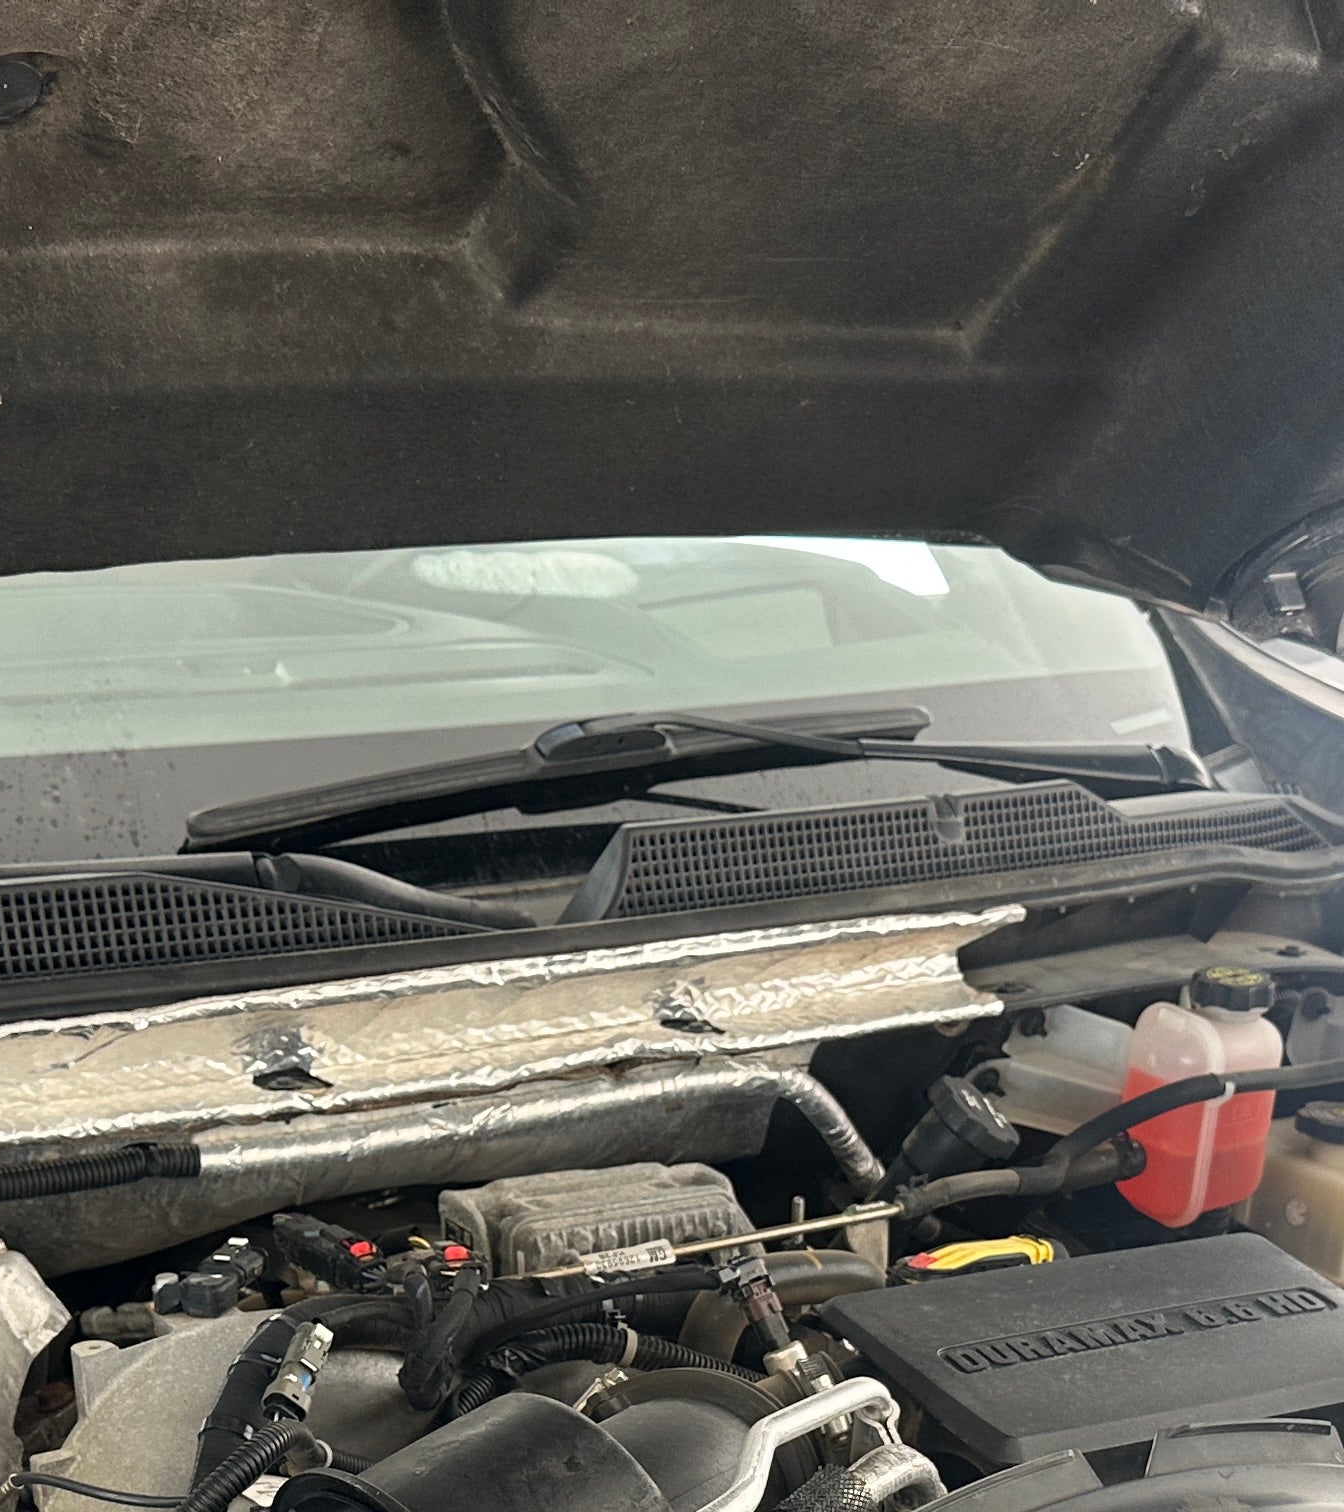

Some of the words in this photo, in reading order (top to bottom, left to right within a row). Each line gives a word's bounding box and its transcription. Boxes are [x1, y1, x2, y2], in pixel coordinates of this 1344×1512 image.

[946, 1313, 1184, 1374] DURAMAX
[1186, 1300, 1261, 1329] 6.6
[1257, 1288, 1327, 1317] HD
